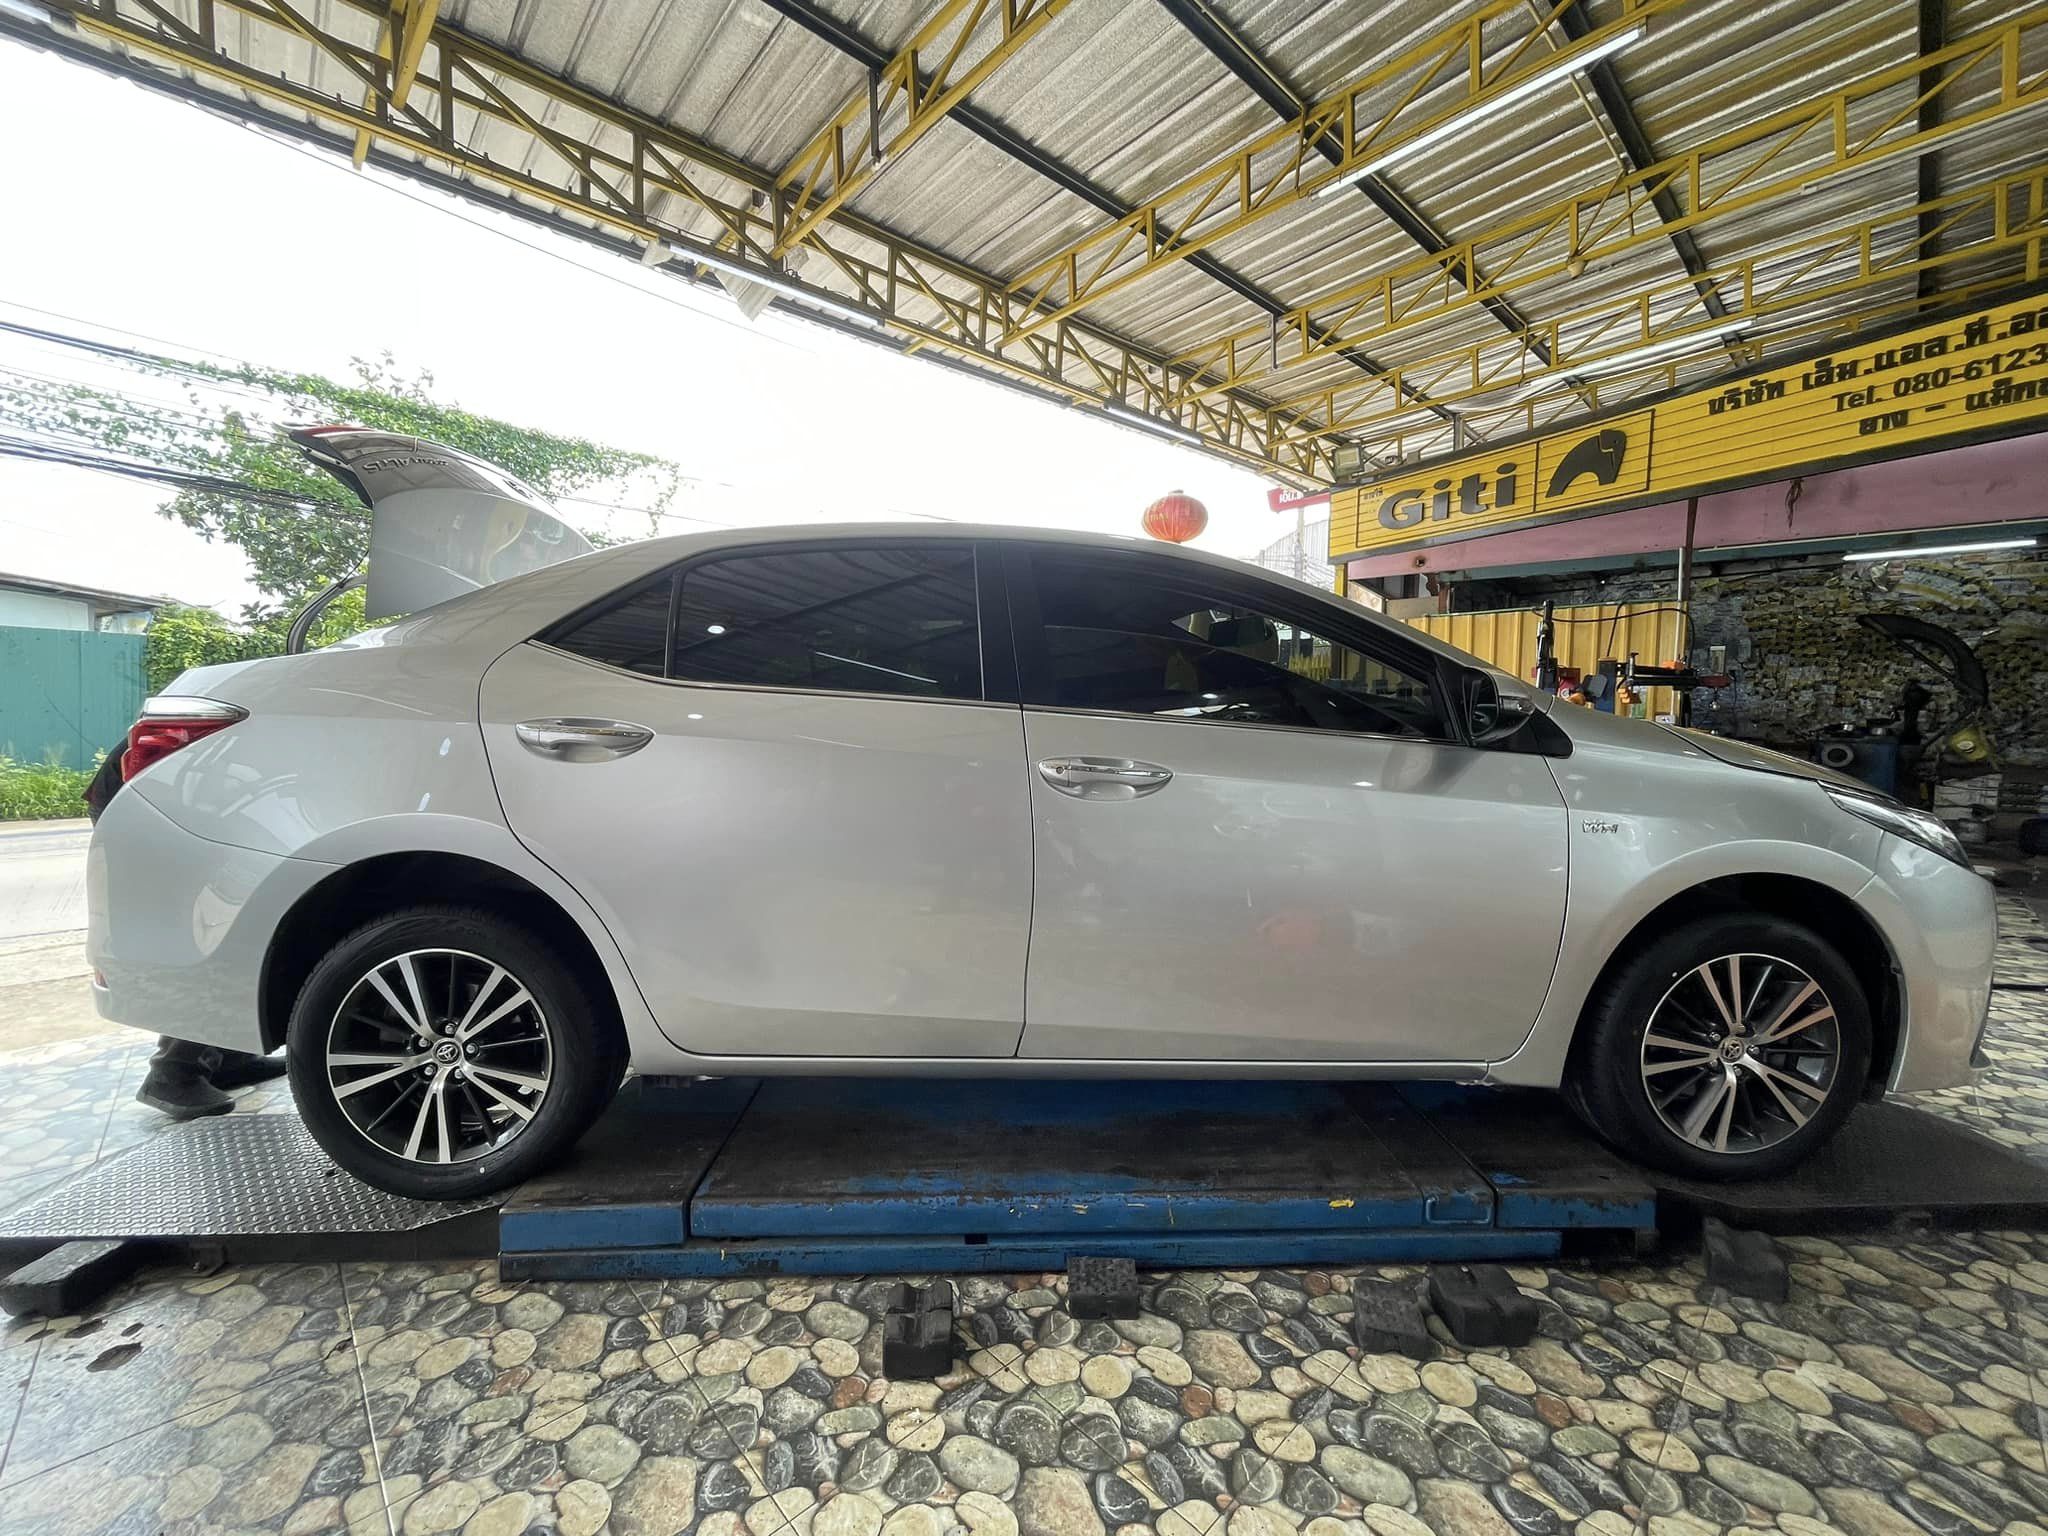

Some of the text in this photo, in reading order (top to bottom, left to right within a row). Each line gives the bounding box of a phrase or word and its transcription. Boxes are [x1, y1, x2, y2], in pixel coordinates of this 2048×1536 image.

[1709, 379, 1785, 415] บริษัท
[1832, 342, 2048, 412] Tel. 080-6123
[1859, 409, 1908, 435] ยาง
[1378, 462, 1518, 530] Giti
